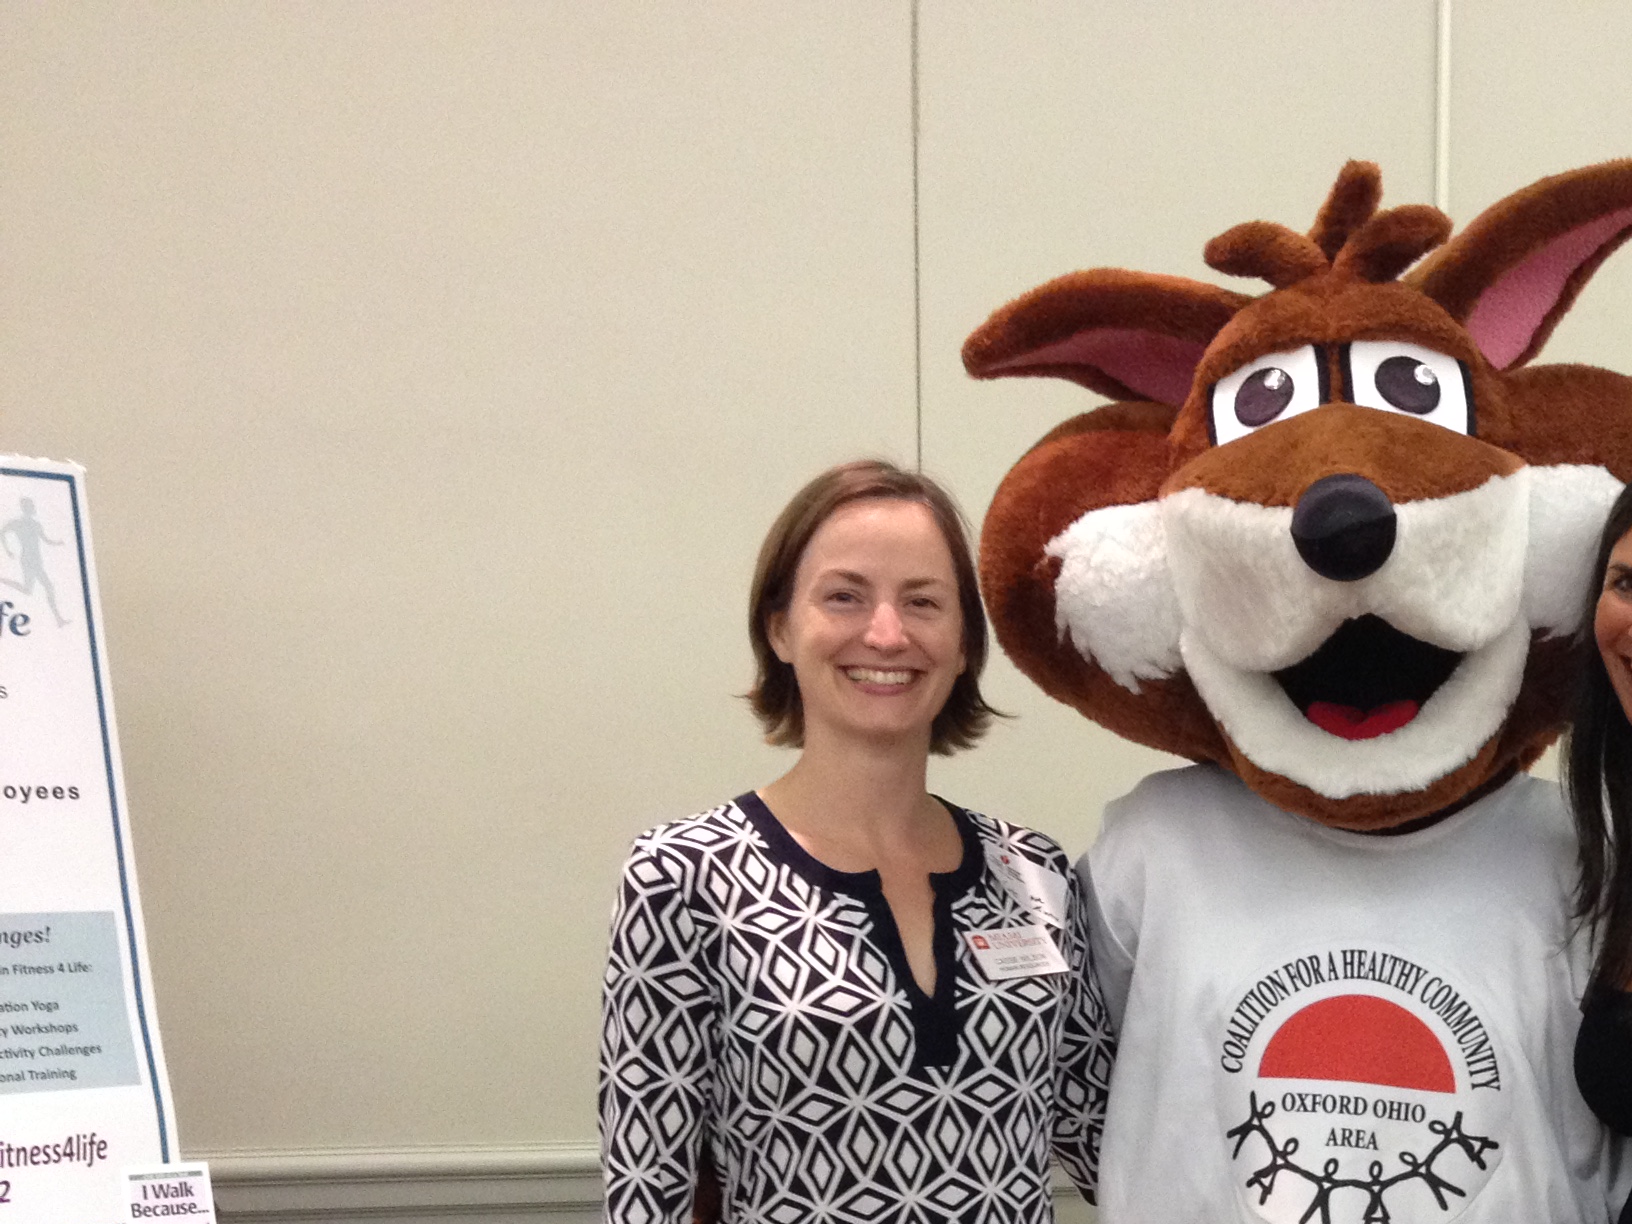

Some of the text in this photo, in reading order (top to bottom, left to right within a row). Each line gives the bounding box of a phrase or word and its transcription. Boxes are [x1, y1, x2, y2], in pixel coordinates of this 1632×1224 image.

[12, 963, 54, 975] Fitness
[57, 963, 65, 973] 4
[32, 1001, 60, 1014] Yoga
[1221, 949, 1501, 1091] COALITION FOR A HEALTHY COMMUNITY
[11, 1022, 79, 1036] Workshops
[38, 1044, 102, 1057] Challenges
[28, 1067, 77, 1081] Training
[1281, 1092, 1426, 1123] OXFORD OHIO
[1326, 1127, 1379, 1151] AREA
[142, 1181, 195, 1200] I Walk
[130, 1202, 210, 1218] Because...
